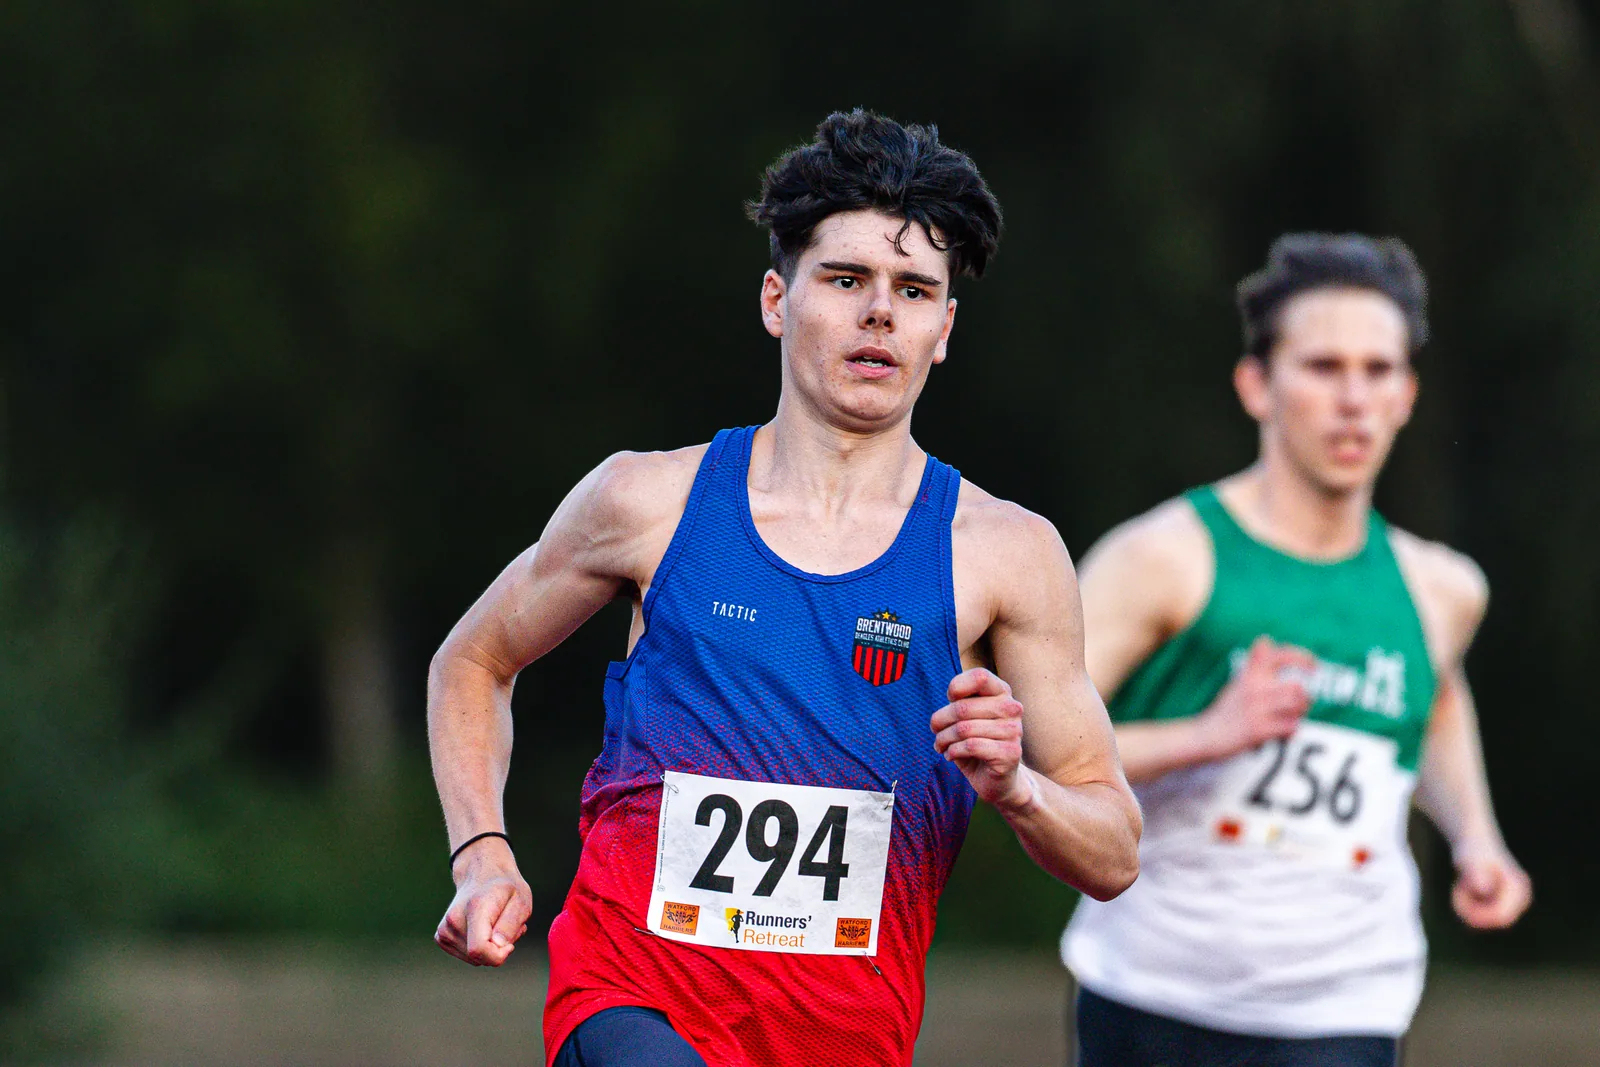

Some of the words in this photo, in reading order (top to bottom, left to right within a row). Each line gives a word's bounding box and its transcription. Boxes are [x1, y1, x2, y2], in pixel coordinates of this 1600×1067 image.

[712, 601, 757, 622] TACTIC
[856, 617, 912, 640] BRENTWOOD
[874, 634, 898, 646] ATHLETICS
[1246, 736, 1361, 826] 256
[689, 793, 850, 901] 294
[667, 904, 697, 912] WATFORD
[663, 924, 693, 933] HARRIERS
[743, 930, 806, 948] Retreat
